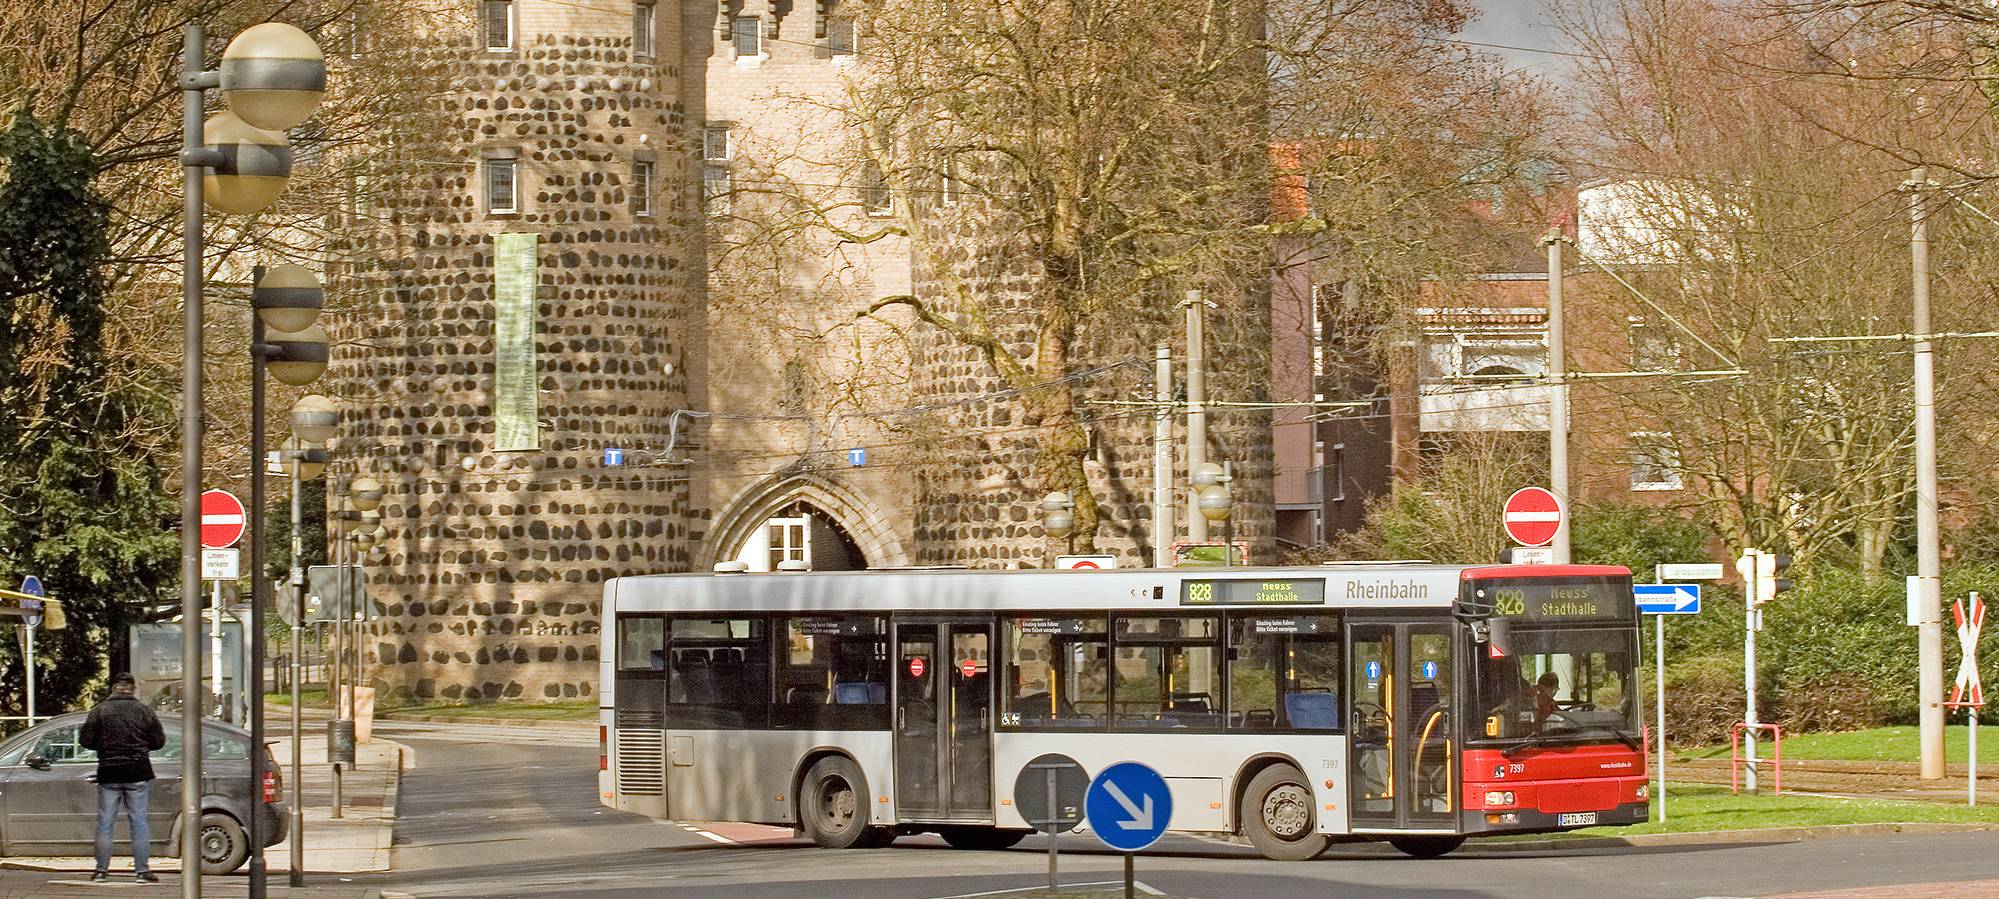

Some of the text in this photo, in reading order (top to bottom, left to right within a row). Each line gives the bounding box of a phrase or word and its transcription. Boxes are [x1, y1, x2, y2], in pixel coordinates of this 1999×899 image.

[607, 451, 620, 464] T
[851, 450, 863, 463] T
[1189, 583, 1212, 601] 828
[1346, 579, 1428, 599] Rheinbahn
[1256, 592, 1299, 602] Stadthalle
[1495, 589, 1525, 615] 828
[1541, 602, 1598, 616] Stadthalle
[1321, 759, 1339, 769] 7397
[1509, 763, 1525, 774] 7397
